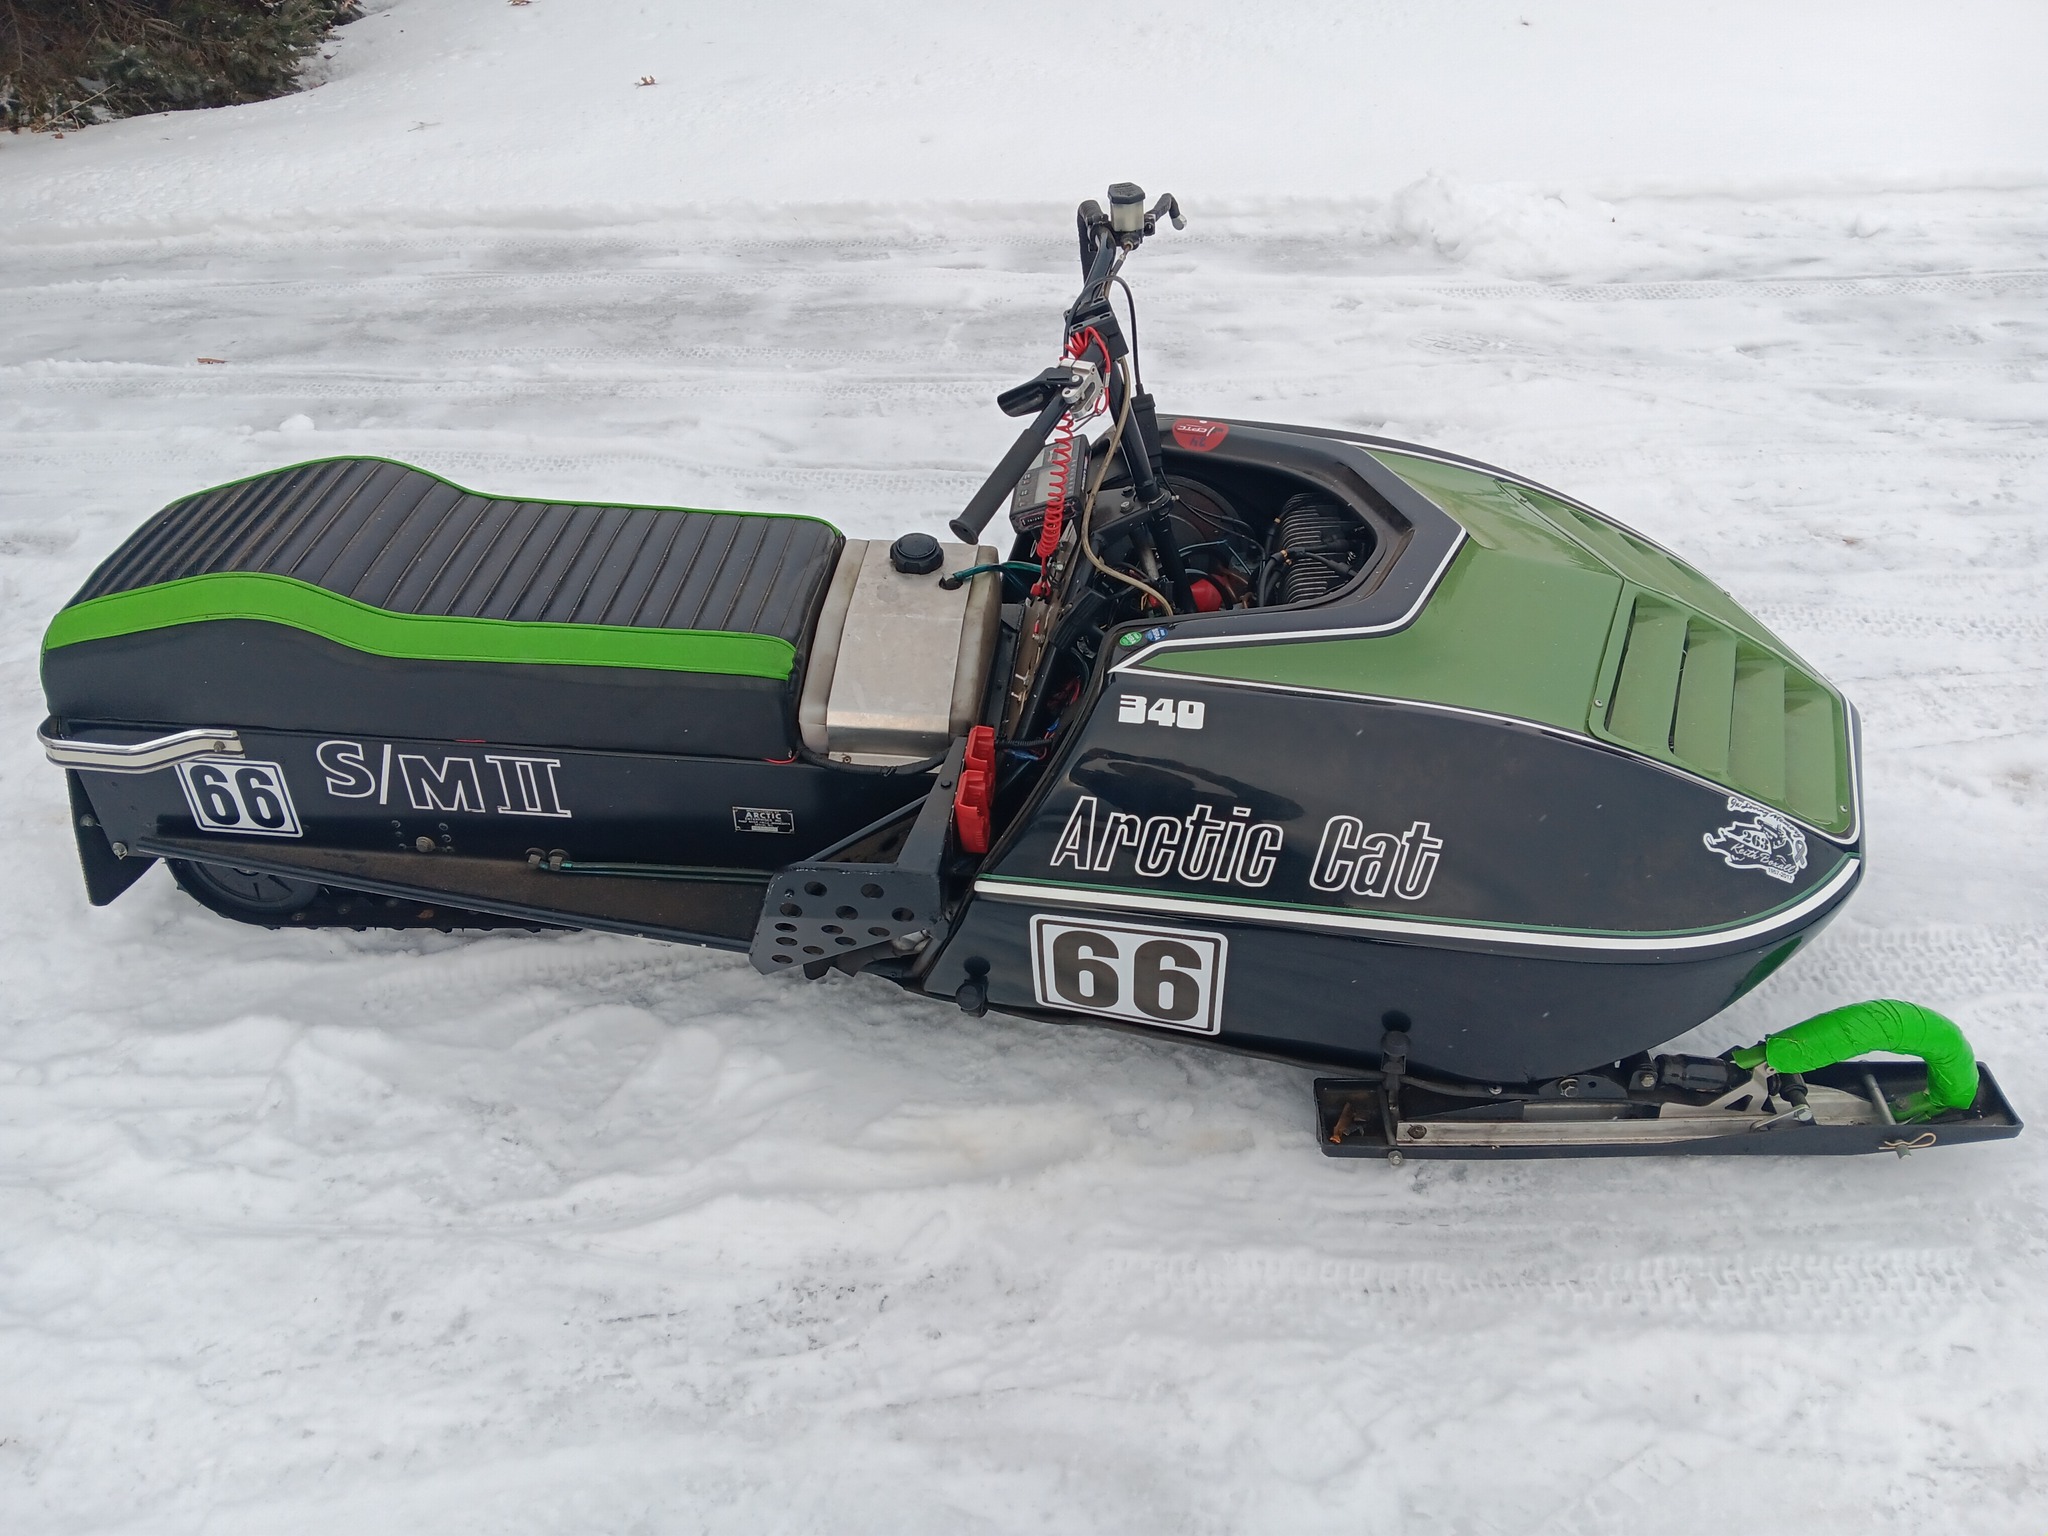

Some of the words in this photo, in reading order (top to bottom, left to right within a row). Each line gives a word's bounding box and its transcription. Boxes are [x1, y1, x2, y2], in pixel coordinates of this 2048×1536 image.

[1118, 694, 1205, 729] 340
[196, 765, 285, 829] 66
[746, 812, 782, 820] ARCTIC
[1050, 796, 1283, 887] Arctic
[1309, 815, 1443, 900] Cat
[1730, 842, 1760, 860] Keith
[1760, 854, 1795, 873] Boxall
[1742, 830, 1770, 850] 263
[1053, 930, 1202, 1020] 66
